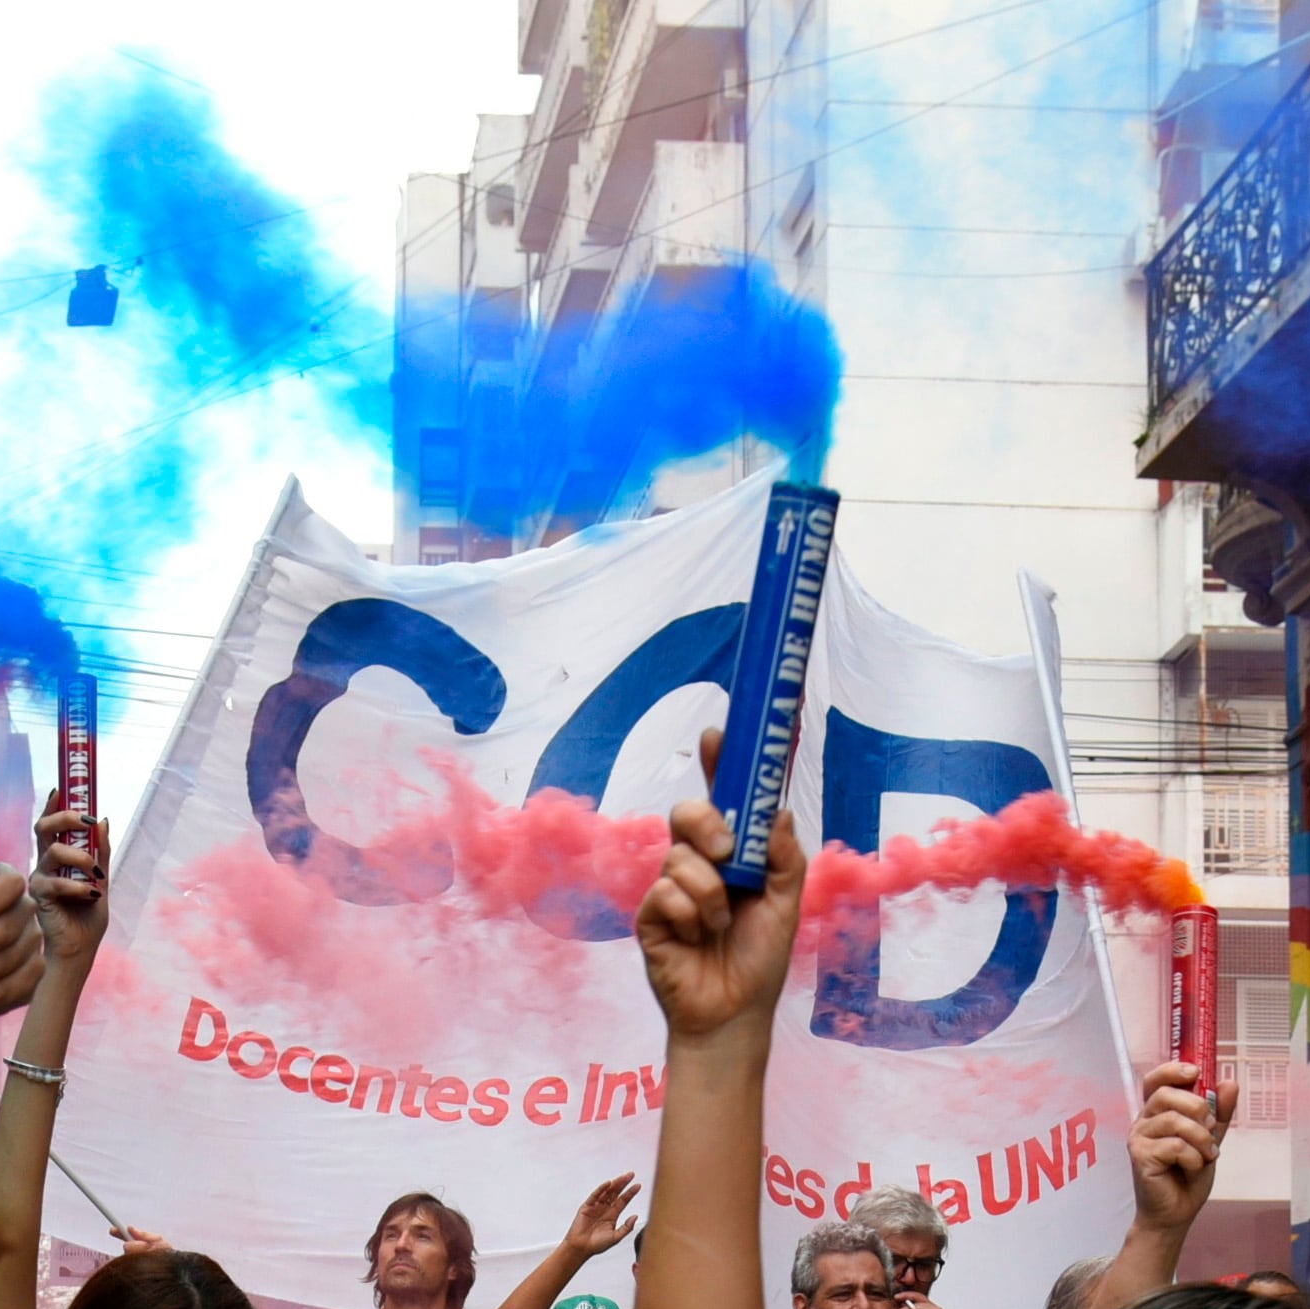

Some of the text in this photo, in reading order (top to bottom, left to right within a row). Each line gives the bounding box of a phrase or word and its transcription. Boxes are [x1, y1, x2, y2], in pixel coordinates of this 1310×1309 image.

[68, 681, 89, 745] HUMO
[741, 508, 834, 866] BENGALA DE HUMO
[68, 750, 89, 778] DE
[1171, 1006, 1182, 1046] COLOR
[178, 996, 510, 1127] Docentes
[523, 1075, 568, 1126] e
[834, 1162, 871, 1222] d
[977, 1108, 1098, 1216] UNR
